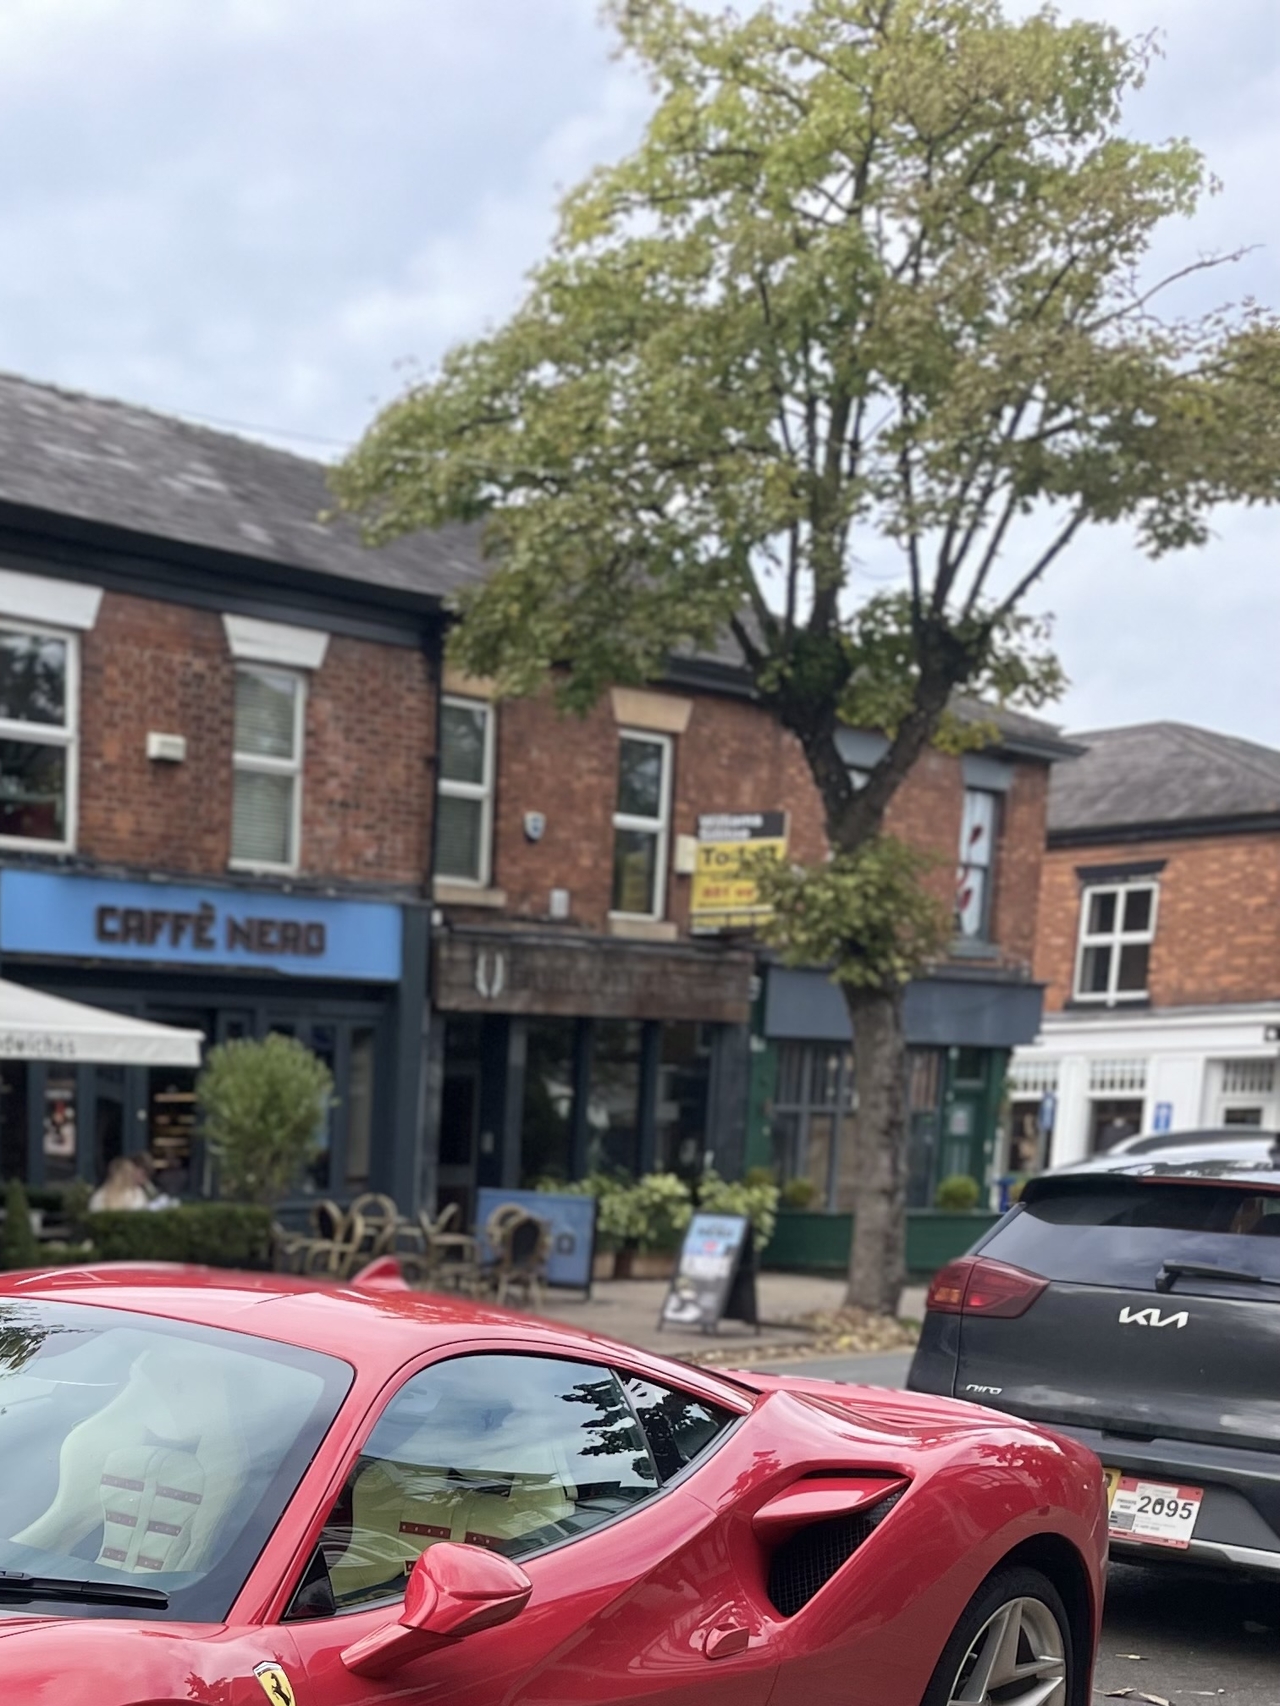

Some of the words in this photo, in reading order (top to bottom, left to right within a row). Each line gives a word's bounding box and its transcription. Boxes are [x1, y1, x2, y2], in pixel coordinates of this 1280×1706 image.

[702, 846, 729, 867] To
[225, 915, 326, 957] NERO
[1137, 1495, 1194, 1520] 2095
